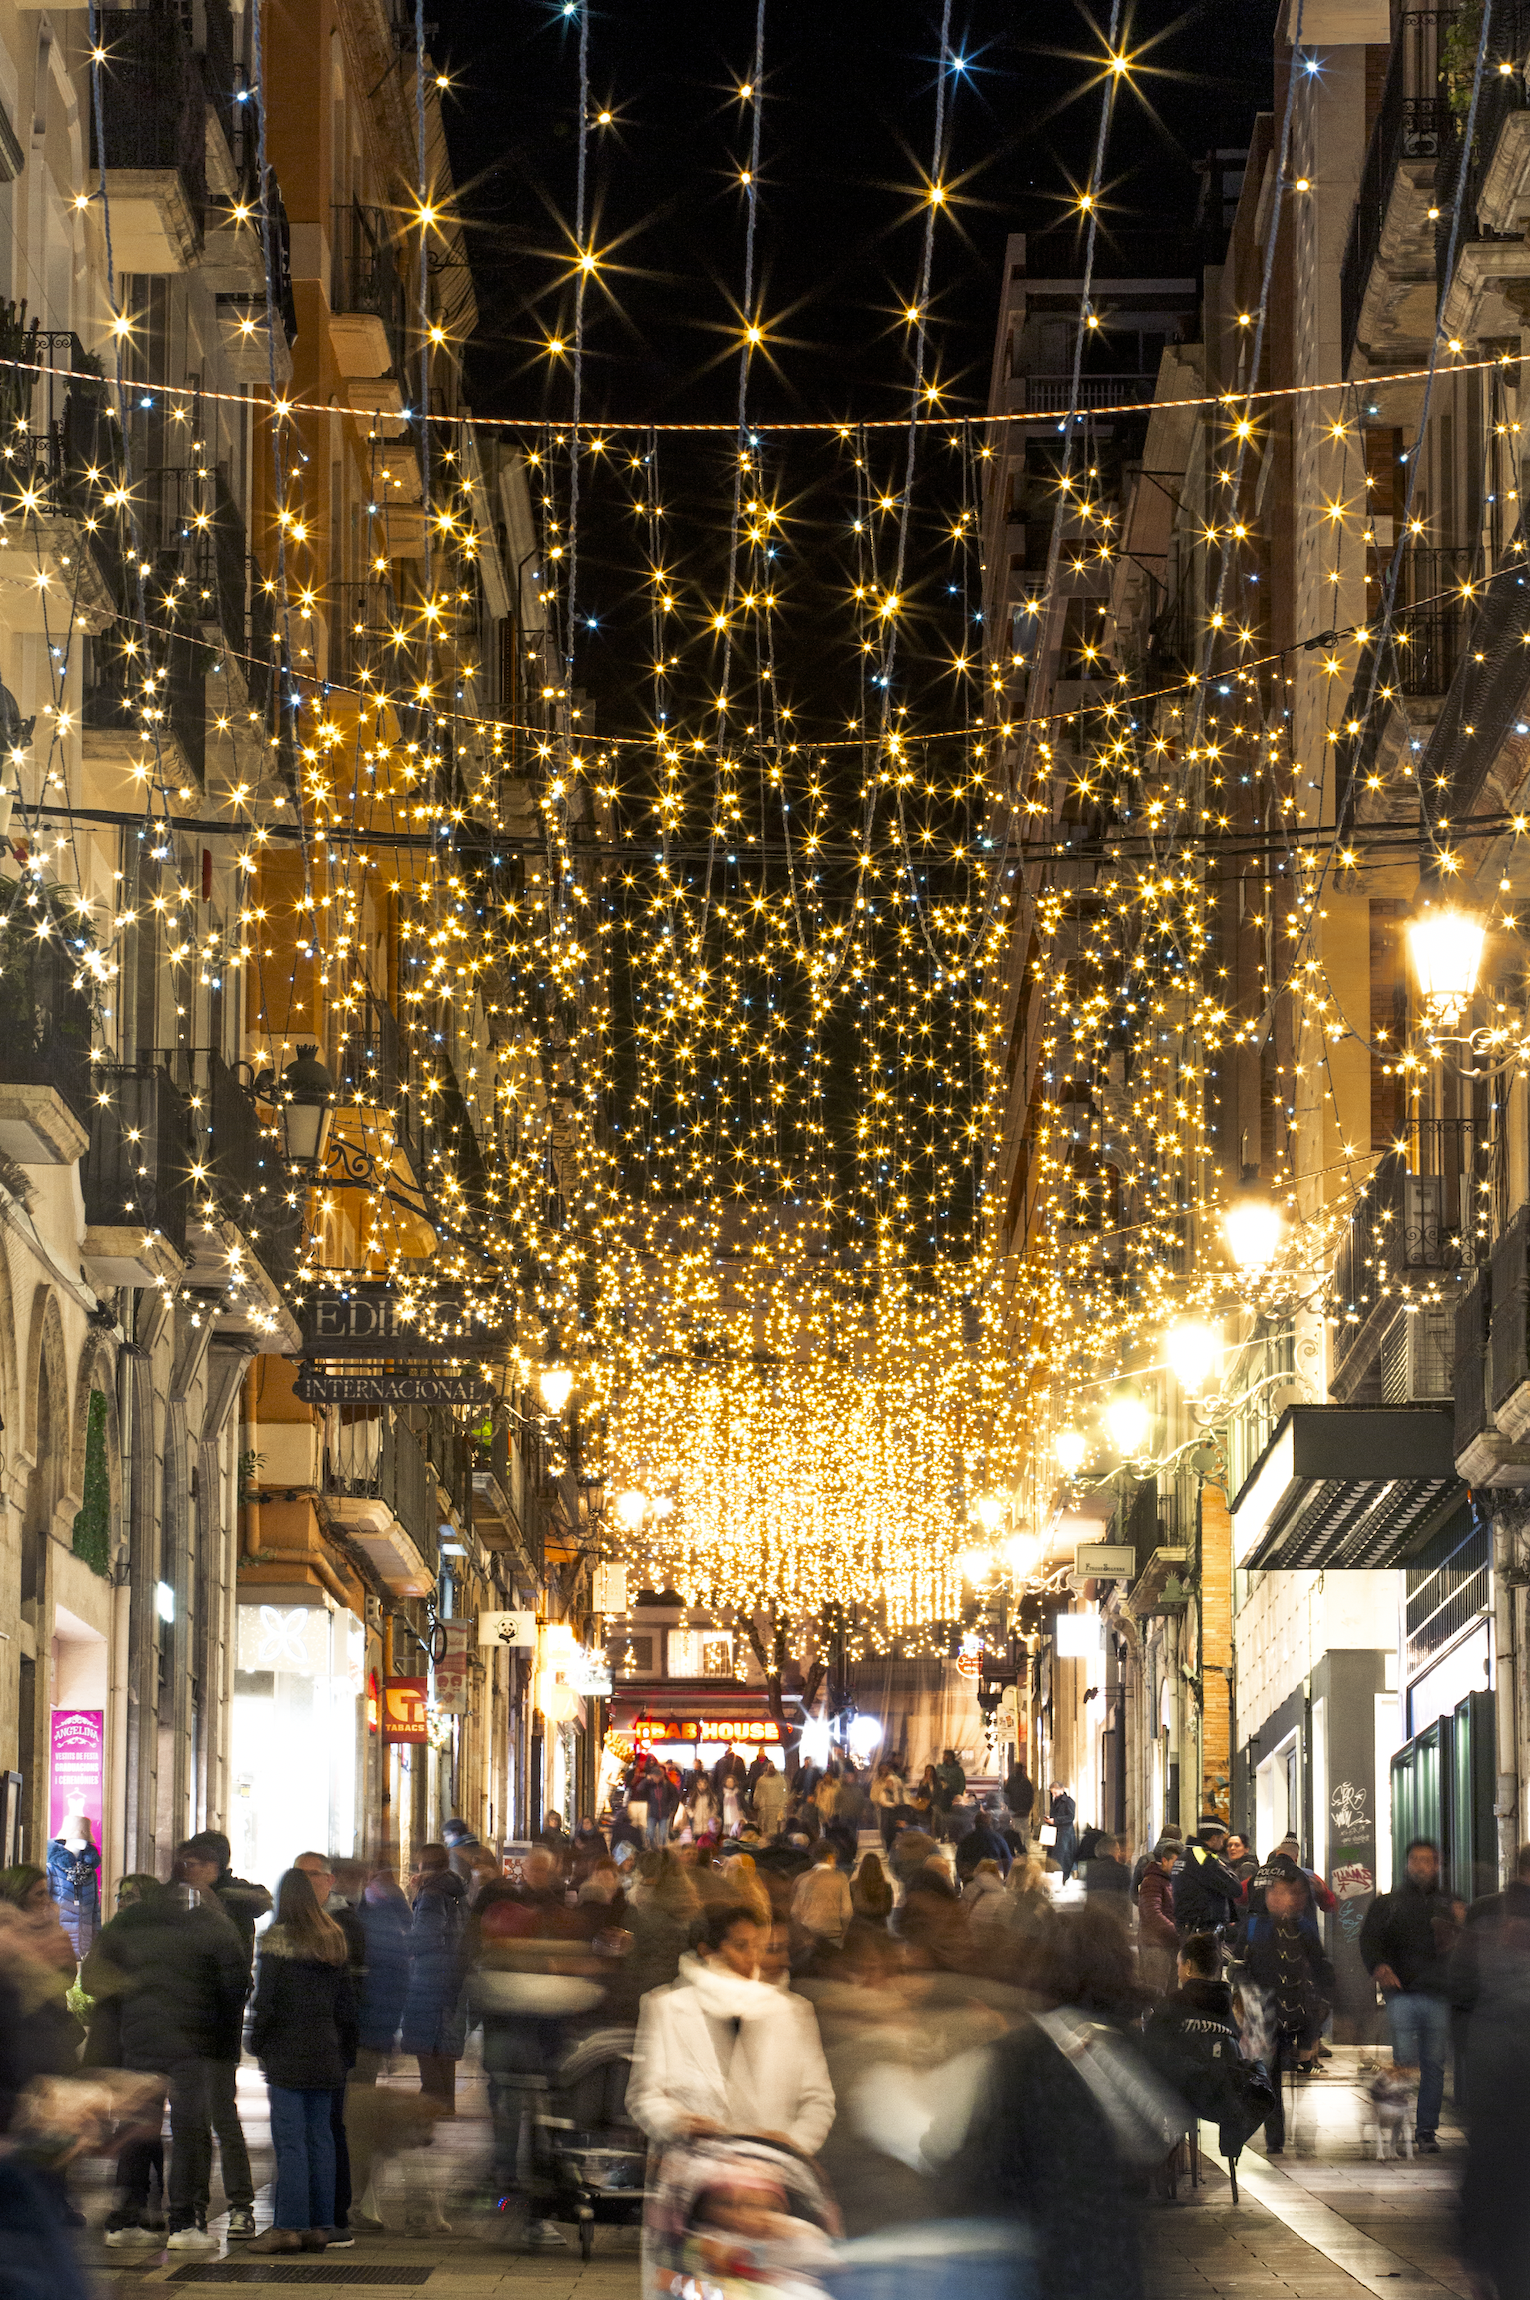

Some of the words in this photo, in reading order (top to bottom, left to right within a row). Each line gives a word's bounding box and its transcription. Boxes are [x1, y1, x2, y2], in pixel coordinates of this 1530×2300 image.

[305, 1379, 482, 1399] INTERNACIONAL
[54, 1726, 99, 1742] ANGELINA
[385, 1723, 425, 1732] TABACS
[701, 1722, 780, 1741] HOUSE
[76, 1752, 83, 1761] DE
[84, 1752, 99, 1761] FESTA
